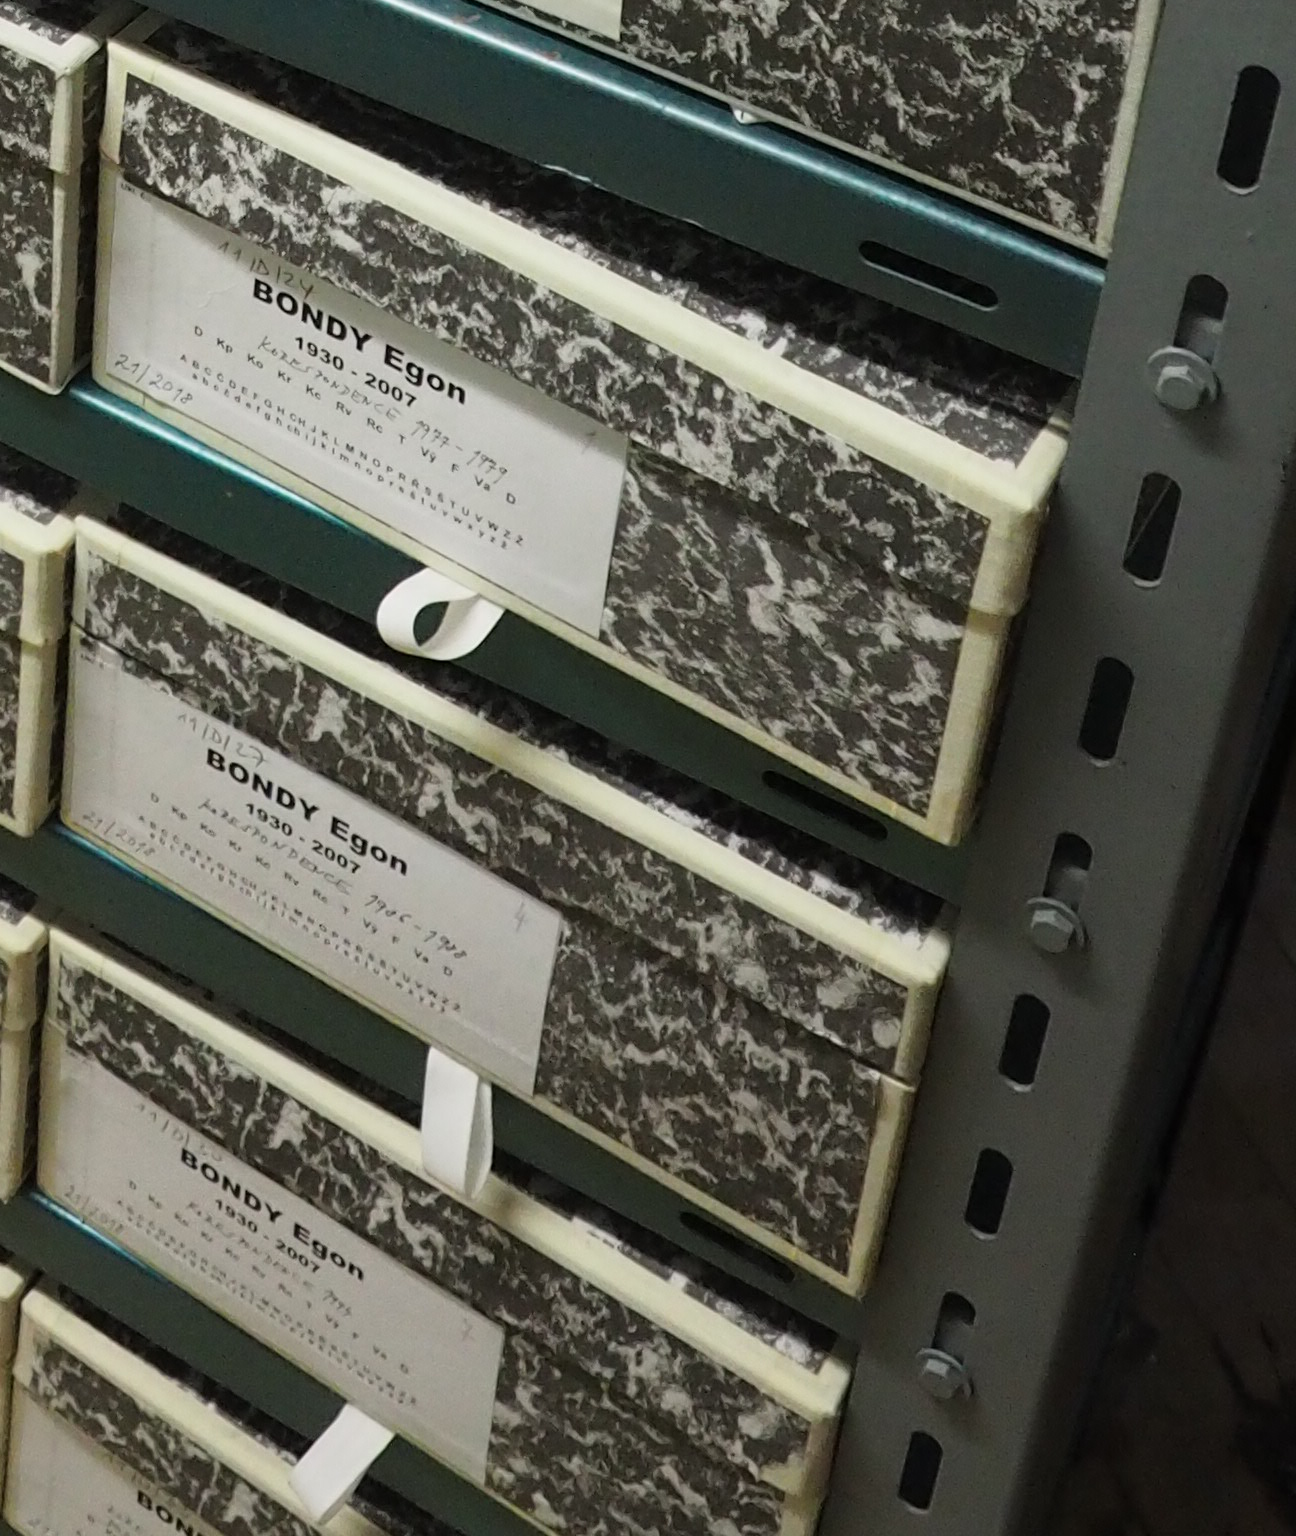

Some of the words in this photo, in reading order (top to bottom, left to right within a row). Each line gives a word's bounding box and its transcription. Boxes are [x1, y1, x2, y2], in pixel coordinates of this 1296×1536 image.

[252, 278, 373, 354] BONDY
[384, 342, 468, 406] Egon
[295, 336, 344, 374] 1930
[364, 370, 417, 409] 2007
[206, 748, 320, 822] BONDY
[330, 815, 408, 877] Egon
[246, 803, 293, 837] 1930
[311, 839, 361, 875] 2007
[180, 1147, 284, 1224] BONDY
[292, 1222, 365, 1283] Egon
[214, 1198, 258, 1235] 1930
[274, 1238, 321, 1277] 2007
